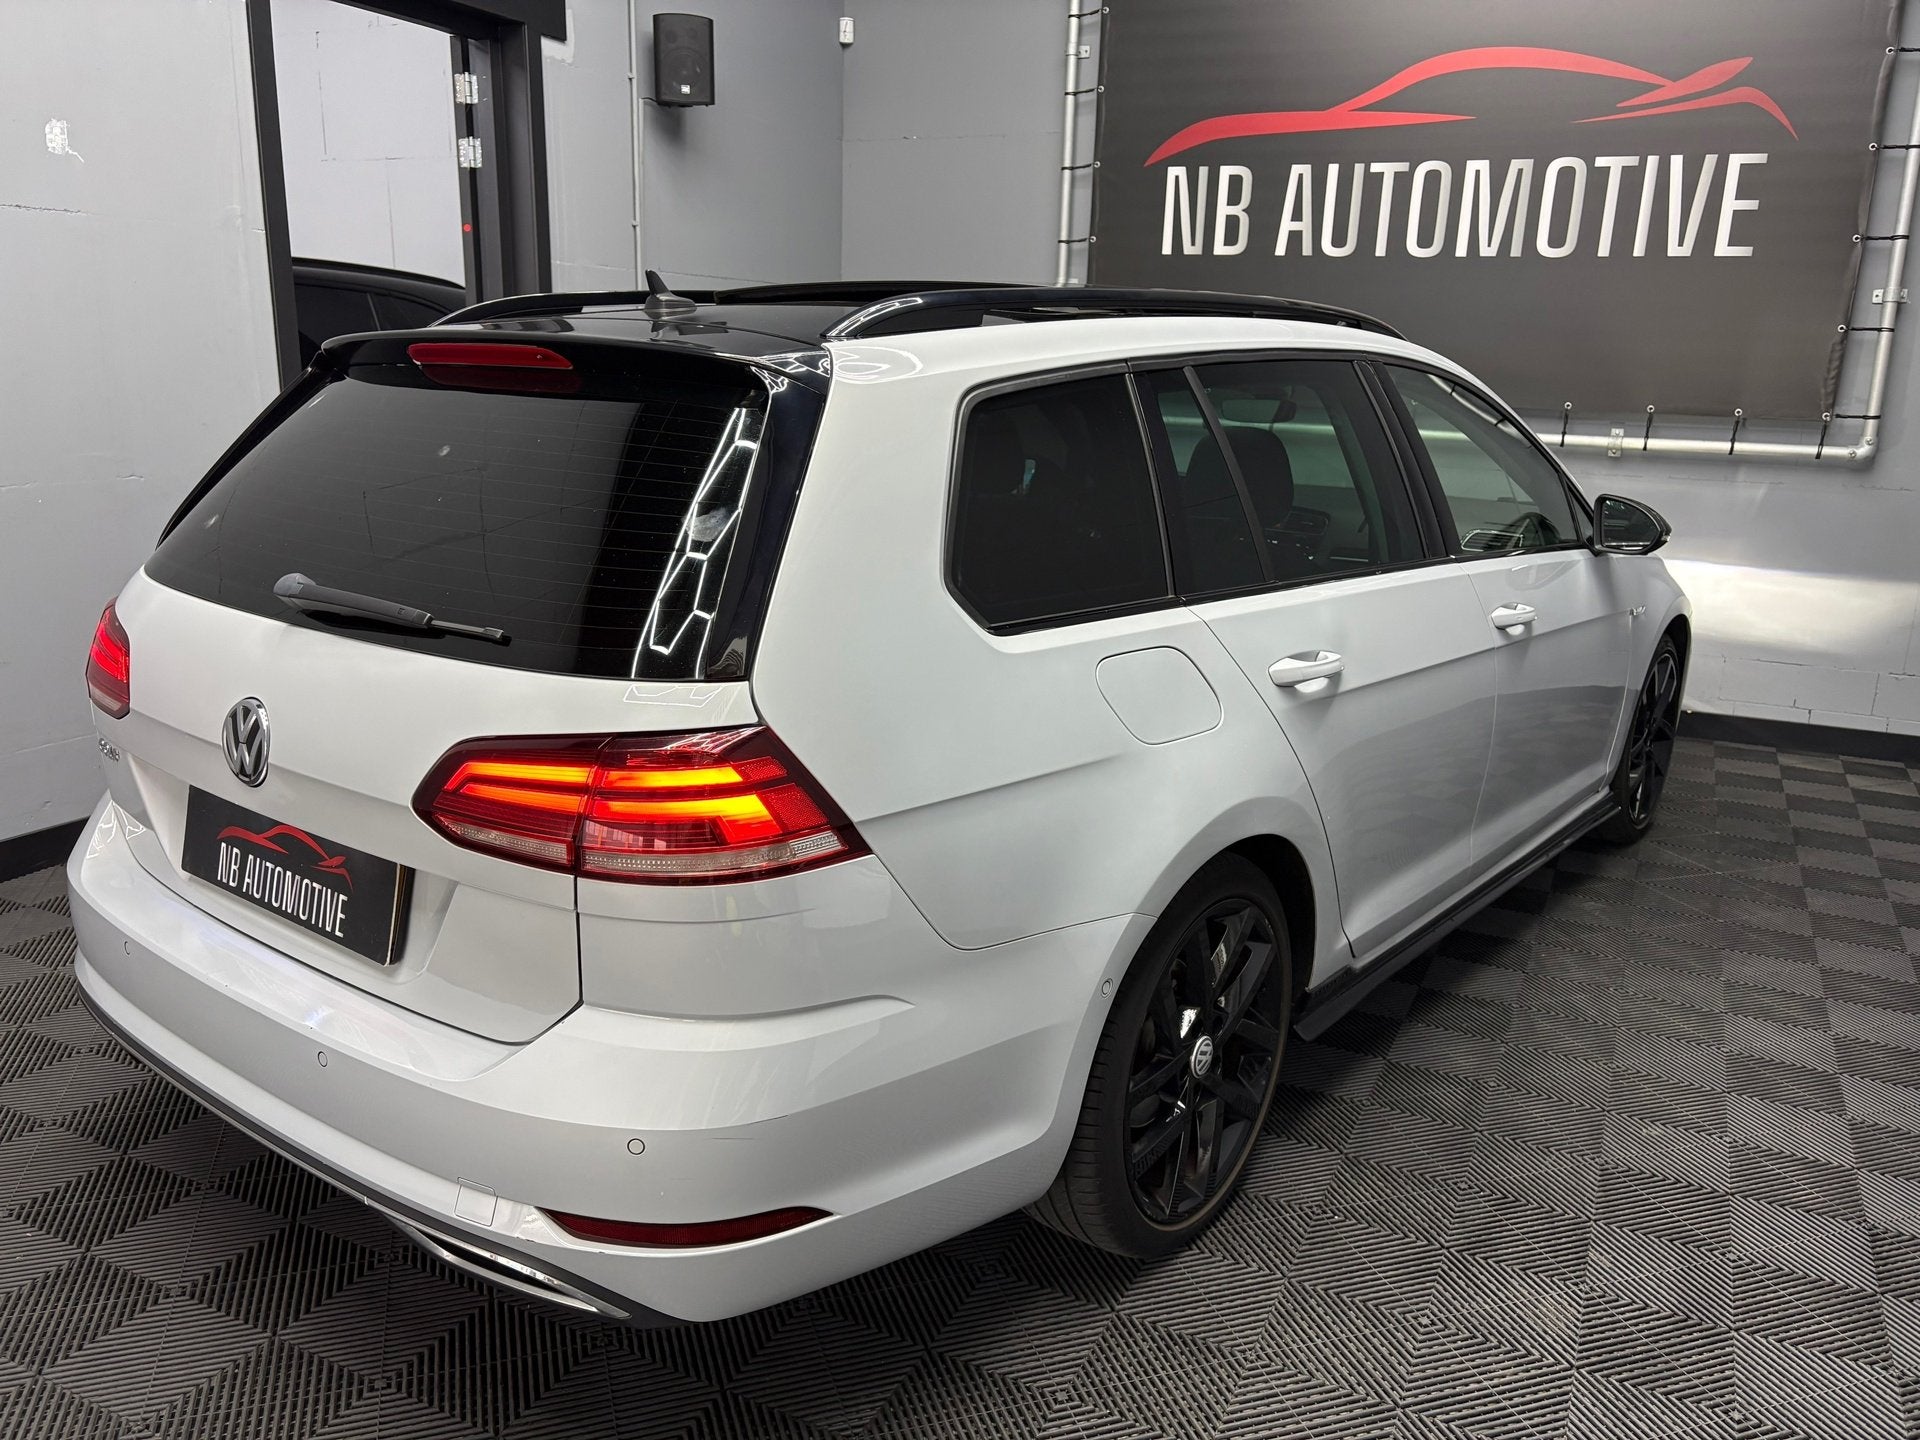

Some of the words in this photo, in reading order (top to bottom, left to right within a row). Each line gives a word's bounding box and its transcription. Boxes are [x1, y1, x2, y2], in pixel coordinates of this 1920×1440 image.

[1161, 165, 1253, 255] NB
[1274, 153, 1768, 258] AUTOMOTIVE
[217, 842, 241, 887] NB
[243, 854, 348, 938] AUTOMOTIVE
